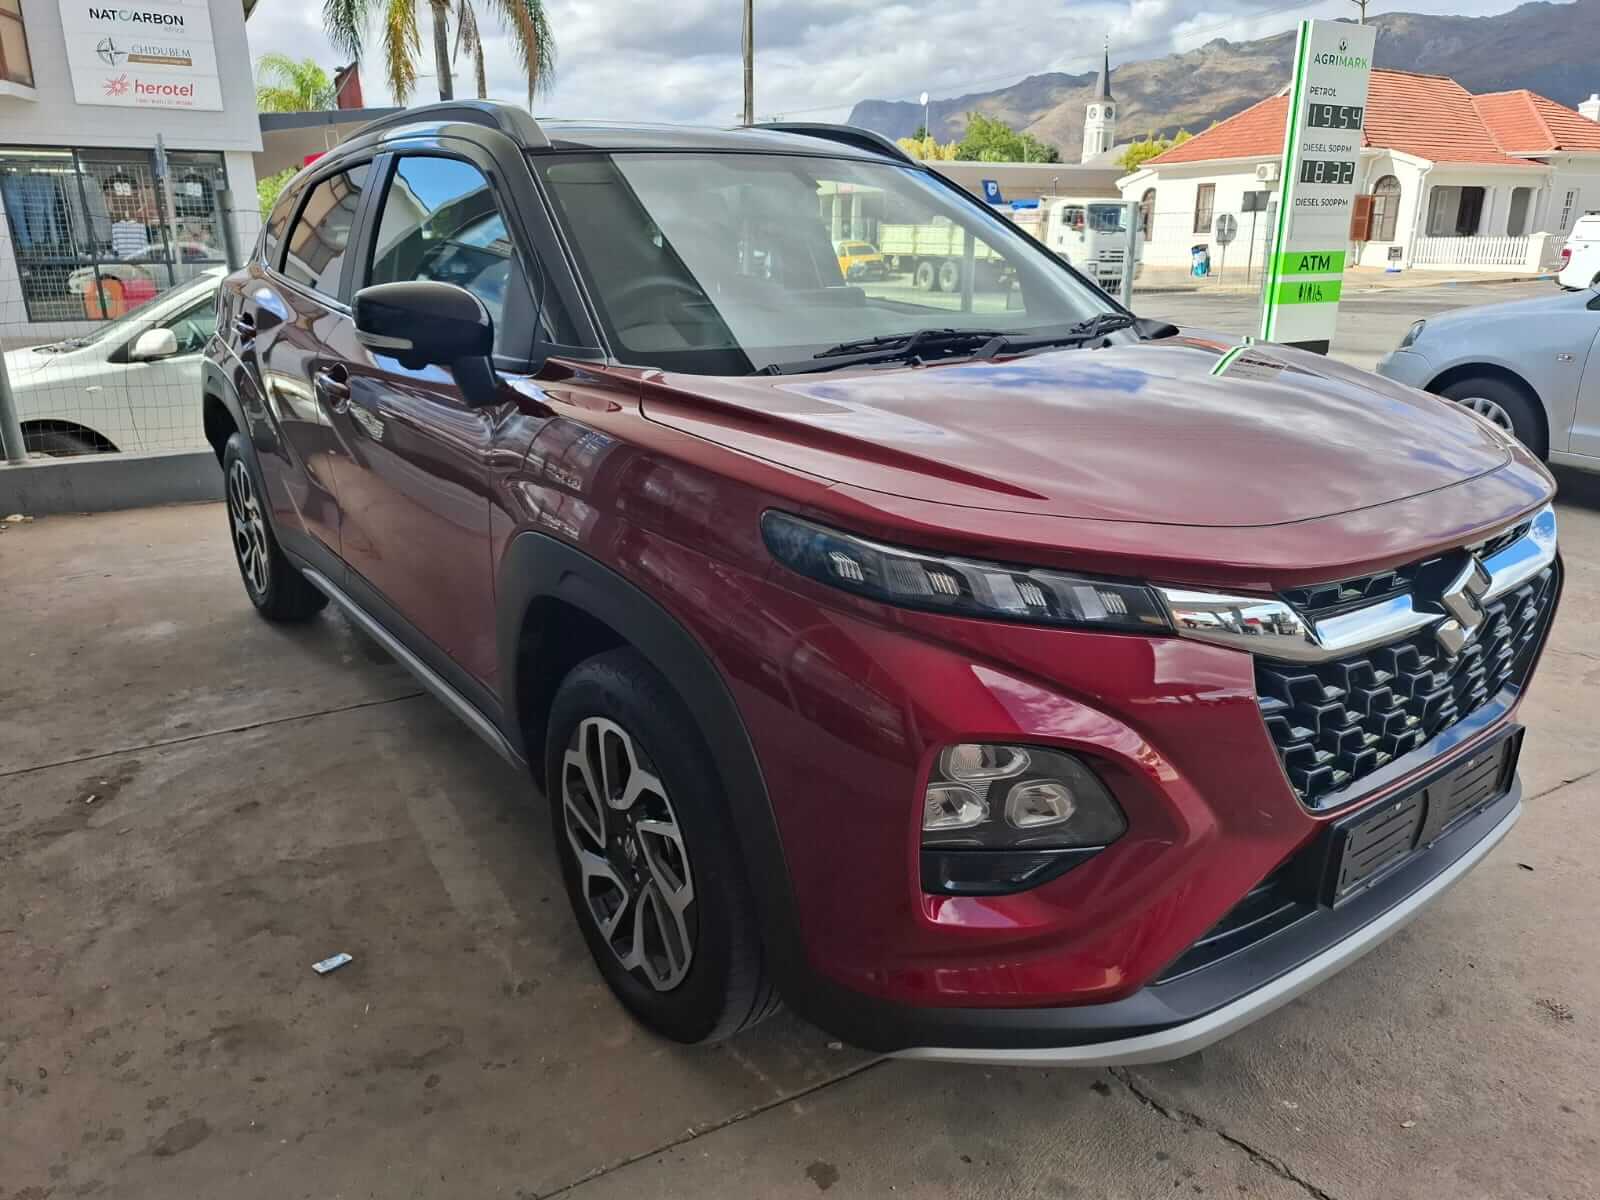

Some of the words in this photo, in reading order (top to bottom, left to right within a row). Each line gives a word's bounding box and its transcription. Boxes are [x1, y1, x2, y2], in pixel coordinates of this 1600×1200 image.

[89, 8, 184, 26] NATCARBON
[131, 43, 192, 57] CHIDUBEM
[1313, 53, 1368, 69] AGRIMARK
[135, 79, 193, 97] herotel
[1310, 86, 1337, 97] PETROL
[1312, 105, 1361, 129] 19.54
[1303, 143, 1327, 152] DIESEL
[1328, 144, 1352, 153] 50PPM
[1305, 161, 1354, 184] 18.32
[1295, 198, 1319, 206] DIESEL
[1320, 199, 1349, 207] 500PPM
[1298, 255, 1331, 271] ATM
